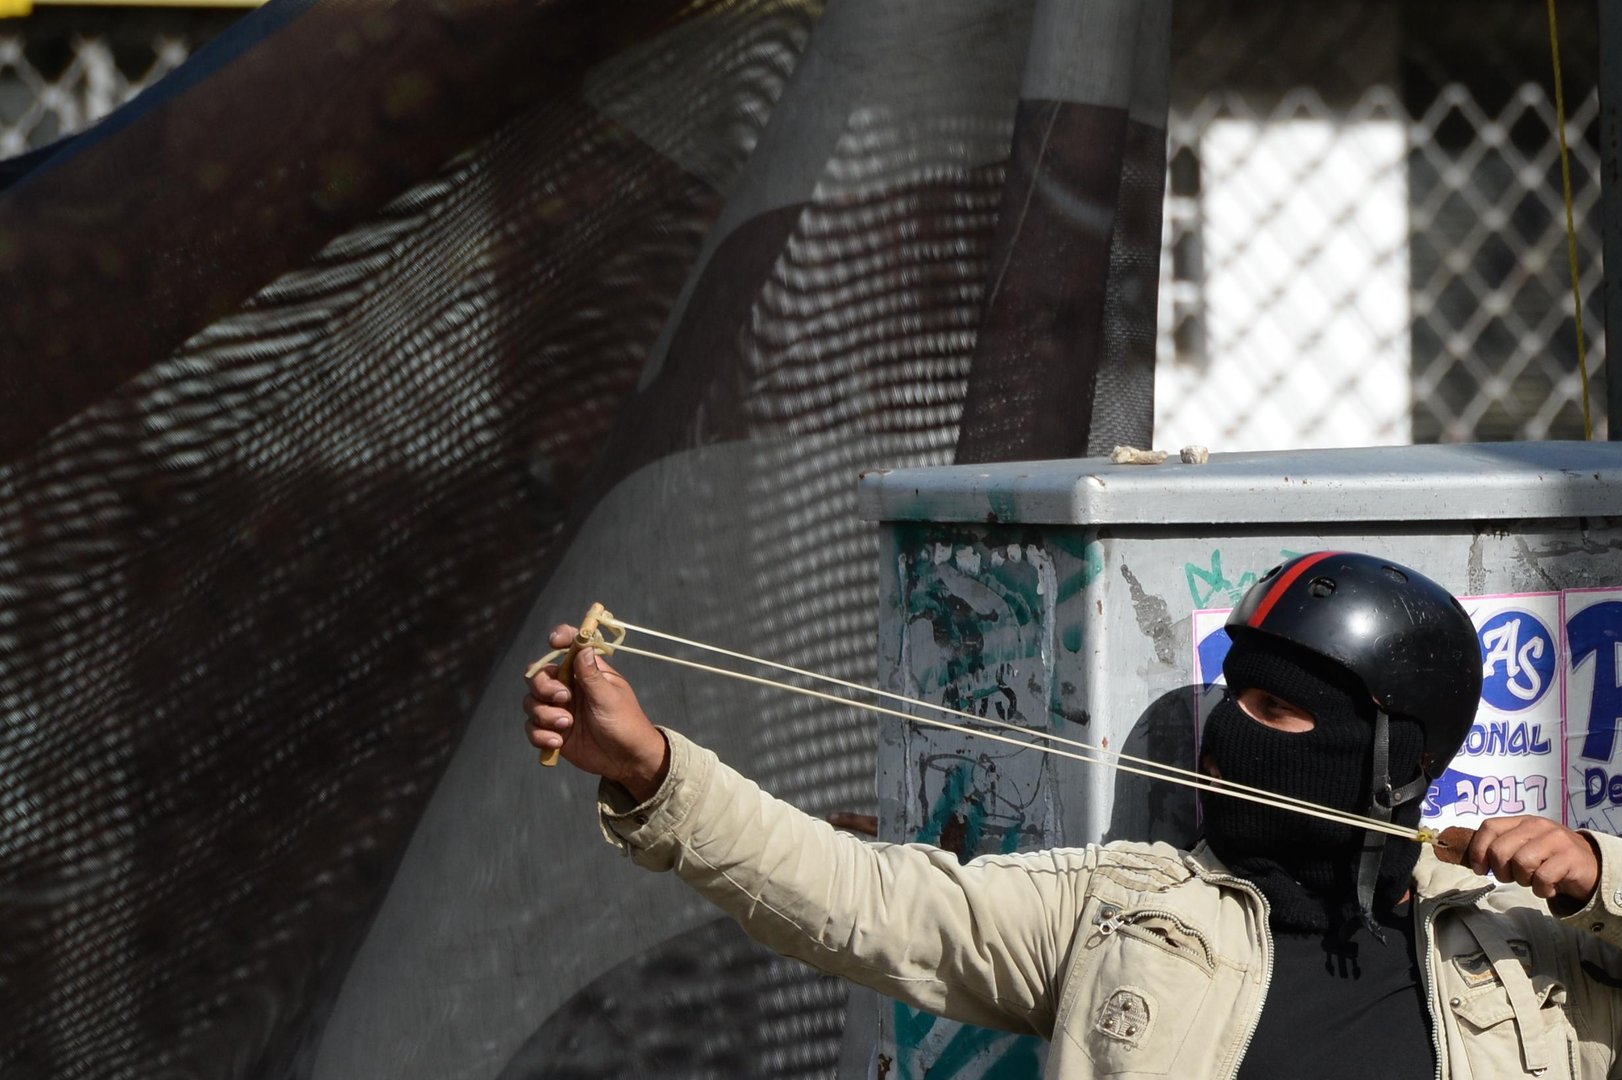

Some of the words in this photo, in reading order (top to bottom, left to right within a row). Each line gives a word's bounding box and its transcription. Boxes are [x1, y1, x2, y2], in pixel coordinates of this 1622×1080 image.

[1482, 618, 1545, 700] AS
[1457, 720, 1551, 757] ONAL
[1454, 774, 1547, 816] 2017
